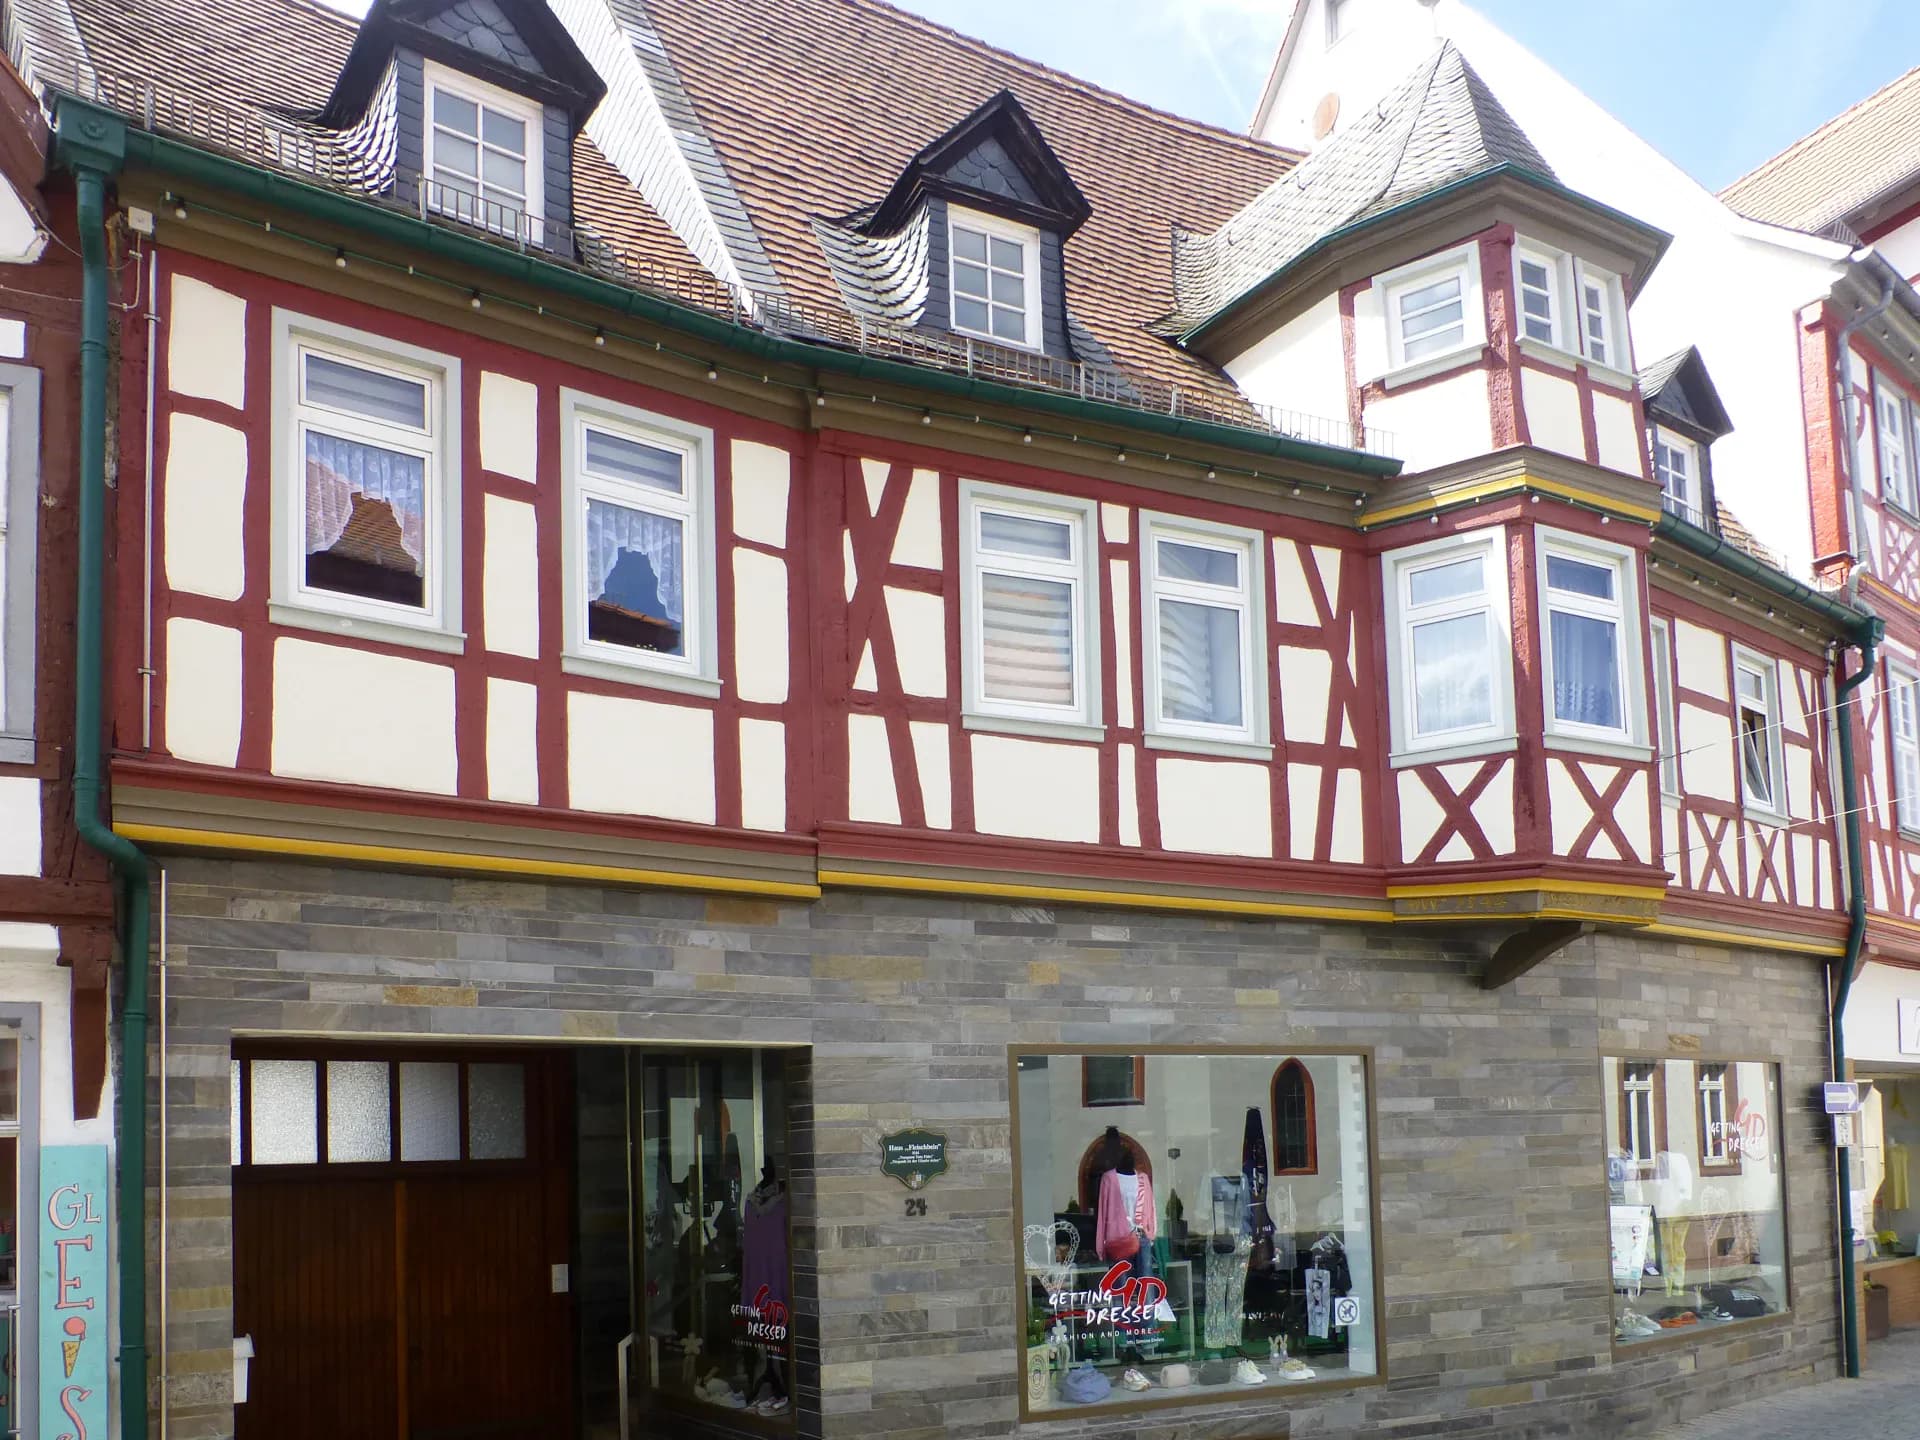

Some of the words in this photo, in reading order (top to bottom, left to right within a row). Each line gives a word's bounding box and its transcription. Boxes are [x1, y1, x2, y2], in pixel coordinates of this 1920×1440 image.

[1049, 1290, 1112, 1309] GETTING
[731, 1304, 761, 1320] GETTING
[747, 1321, 787, 1340] DRESSED
[1100, 1331, 1120, 1339] AND
